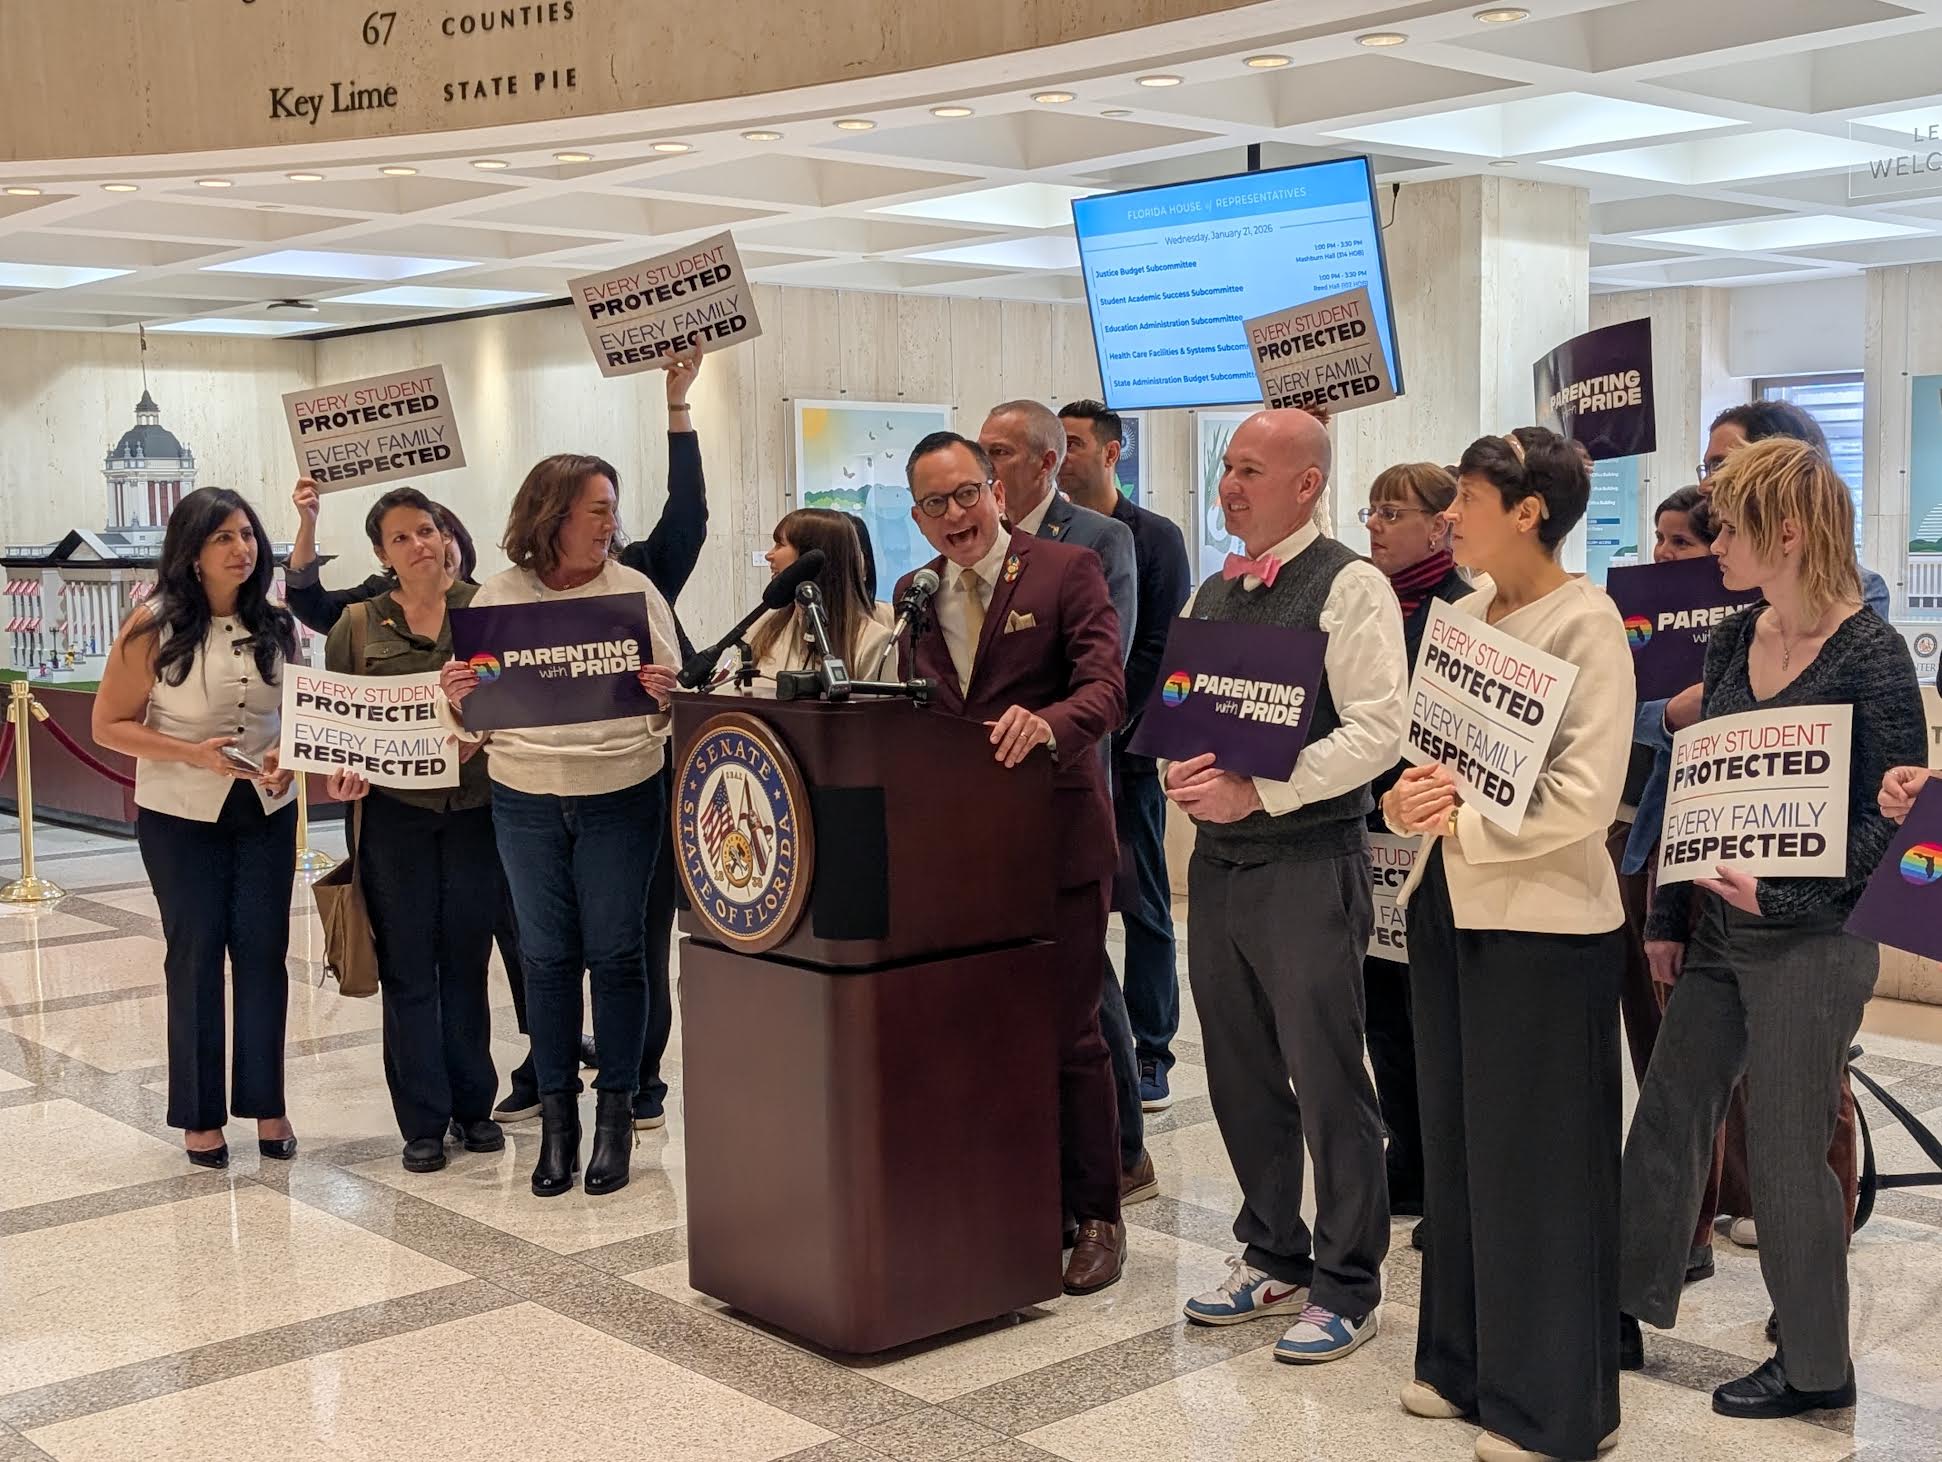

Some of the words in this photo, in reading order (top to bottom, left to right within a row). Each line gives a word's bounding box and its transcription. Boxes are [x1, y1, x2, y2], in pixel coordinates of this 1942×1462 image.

[362, 11, 397, 45] 67
[441, 1, 575, 36] COUNTIES
[269, 87, 324, 125] Key
[330, 81, 398, 113] Lime
[443, 75, 517, 102] STATE
[534, 68, 577, 91] PIE
[1127, 207, 1167, 220] FLORIDA
[1169, 201, 1202, 215] HOUSE
[1215, 186, 1307, 208] REPRESENTATIVES
[1165, 233, 1210, 246] Wednesday,
[1211, 229, 1242, 240] January
[1243, 226, 1253, 236] 21,
[1254, 223, 1273, 235] 2026
[583, 274, 640, 303] EVERY
[646, 245, 724, 285] STUDENT
[1096, 268, 1119, 279] Justice
[1120, 265, 1145, 277] Budget
[1146, 260, 1197, 273] Subcommittee
[588, 264, 732, 320] PROTECTED
[1100, 296, 1127, 305] Student
[1127, 292, 1161, 303] Academic
[1162, 290, 1190, 300] Success
[1191, 284, 1244, 297] Subcommittee
[600, 320, 666, 350] EVERY
[673, 294, 739, 332] FAMILY
[606, 314, 747, 367] RESPECTED
[1105, 322, 1138, 333] Education
[1139, 317, 1190, 330] Administration
[1190, 313, 1243, 326] Subcommittee
[1252, 319, 1291, 345] EVERY
[1296, 300, 1361, 333] STUDENT
[1257, 319, 1367, 363] PROTECTED
[1109, 350, 1132, 360] Health
[1132, 350, 1148, 358] Care
[1149, 346, 1179, 357] Facilities
[1180, 346, 1186, 355] &
[1186, 344, 1216, 356] Systems
[1113, 378, 1131, 387] State
[1132, 374, 1182, 386] Administration
[1183, 372, 1209, 385] Budget
[1210, 369, 1256, 382] Subcommitt
[1265, 369, 1310, 397] EVERY
[1315, 353, 1373, 385] FAMILY
[1550, 369, 1640, 412] PARENTING
[295, 393, 349, 417] EVERY
[355, 377, 434, 405] STUDENT
[298, 394, 439, 435] PROTECTED
[1579, 387, 1642, 415] PRIDE
[306, 439, 371, 467] EVERY
[377, 425, 445, 453] FAMILY
[309, 444, 451, 483] RESPECTED
[1657, 603, 1755, 631] PAREN
[1692, 630, 1711, 643] wit
[503, 638, 639, 668] PARENTING
[538, 666, 568, 679] with
[571, 655, 642, 678] PRIDE
[1431, 618, 1476, 657] EVERY
[1475, 643, 1557, 698] STUDENT
[296, 676, 358, 700] EVERY
[1193, 673, 1306, 707] PARENTING
[1424, 643, 1545, 727] PROTECTED
[1215, 699, 1239, 715] with
[1238, 700, 1302, 727] PRIDE
[295, 723, 367, 750] EVERY
[374, 736, 446, 757] FAMILY
[1412, 691, 1463, 740] EVERY
[1465, 723, 1528, 778] FAMILY
[1676, 733, 1721, 765] EVERY
[1724, 723, 1833, 753] STUDENT
[293, 742, 447, 776] RESPECTED
[696, 738, 772, 782] SENATE
[1408, 719, 1515, 808] RESPECTED
[1673, 750, 1831, 792] PROTECTED
[1667, 806, 1725, 840] EVERY
[1731, 802, 1828, 830] FAMILY
[684, 799, 713, 900] STATE
[715, 898, 738, 925] OF
[744, 811, 792, 928] FLORIDA
[1663, 832, 1826, 867] RESPECTED
